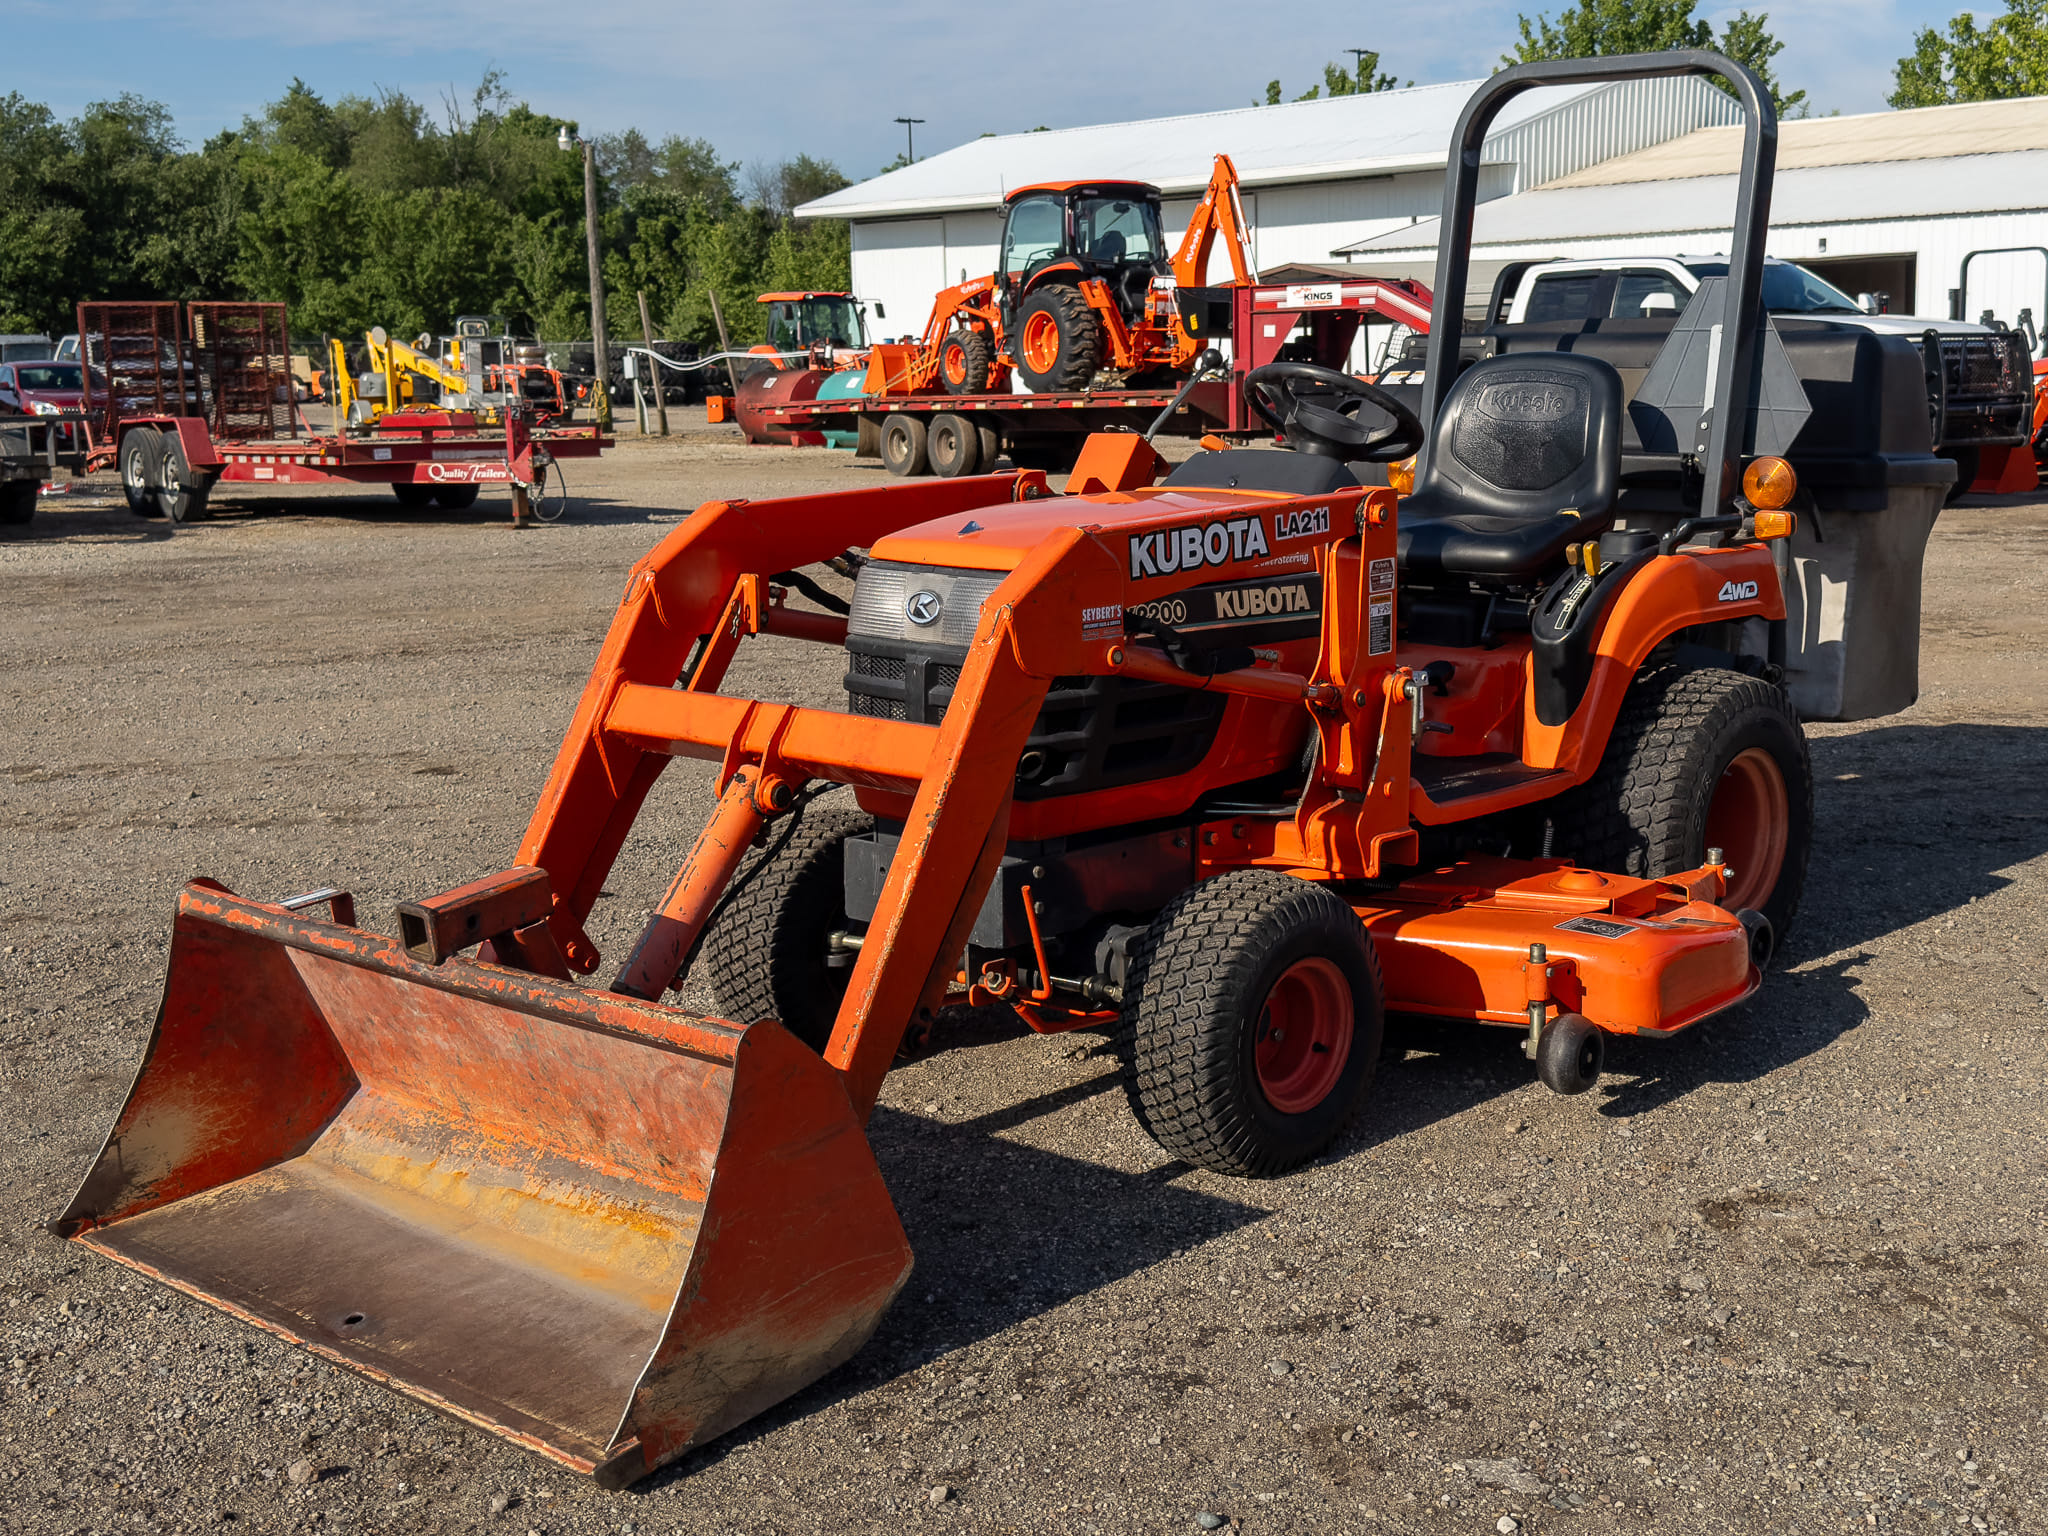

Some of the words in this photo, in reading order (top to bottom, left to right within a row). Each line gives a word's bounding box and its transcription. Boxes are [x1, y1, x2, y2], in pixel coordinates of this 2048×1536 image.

[1185, 229, 1202, 263] Kubota
[1304, 292, 1333, 300] KINGS
[1491, 391, 1563, 412] Kubota
[512, 407, 519, 418] 2
[428, 463, 468, 481] Quality
[469, 464, 506, 482] Trailers
[1129, 515, 1270, 581] KUBOTA
[1275, 507, 1330, 541] LA211
[1718, 580, 1758, 601] 4WD
[1215, 585, 1311, 618] KUBOTA
[1082, 604, 1122, 622] SEYBERT'S
